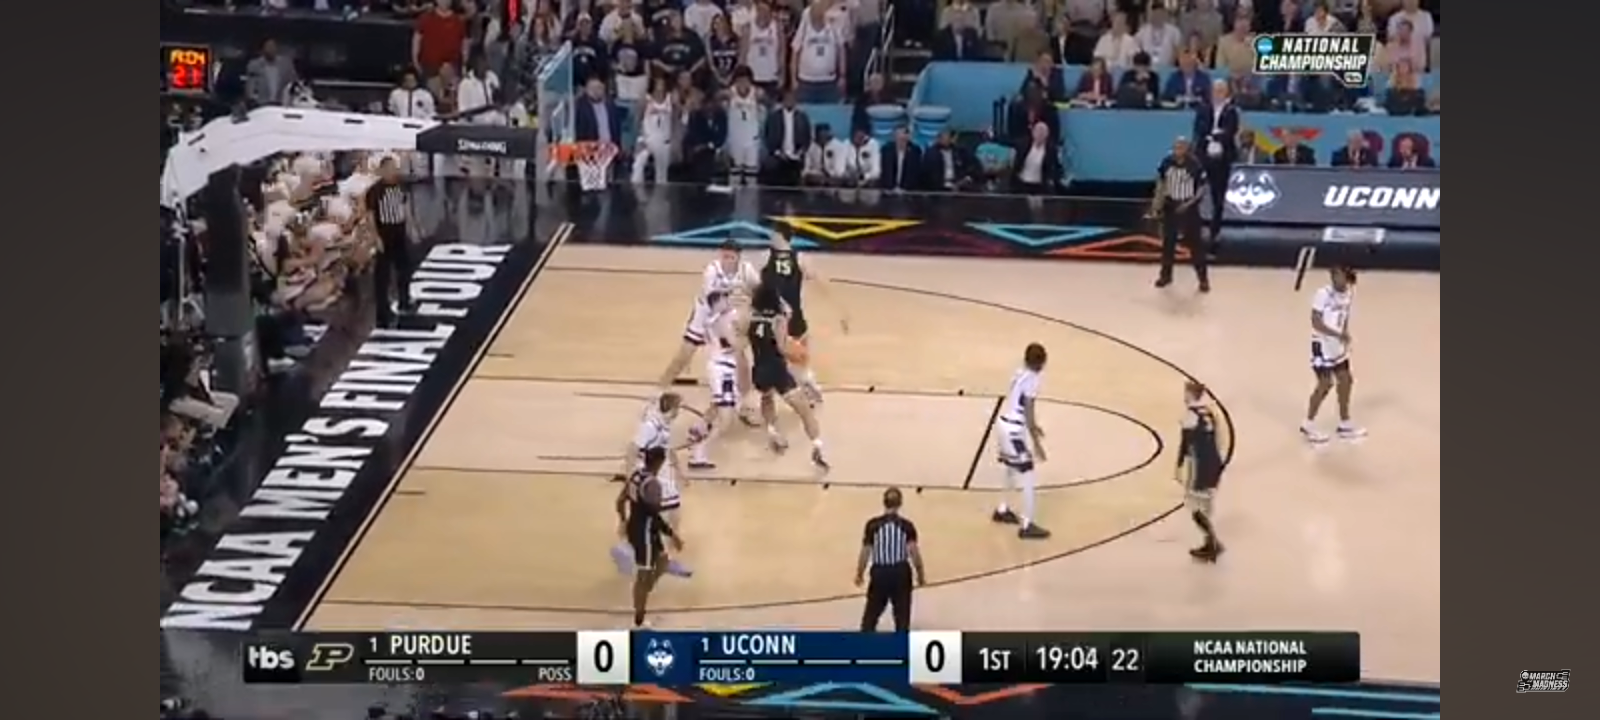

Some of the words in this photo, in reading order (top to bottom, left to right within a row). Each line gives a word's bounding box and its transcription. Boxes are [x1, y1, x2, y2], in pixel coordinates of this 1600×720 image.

[1323, 185, 1440, 209] UCONN
[775, 259, 791, 275] 15
[755, 323, 765, 338] 4
[160, 530, 317, 630] NCAA
[239, 416, 390, 520] MEN'S
[320, 323, 457, 411] FINAL
[391, 242, 514, 318] FOUR
